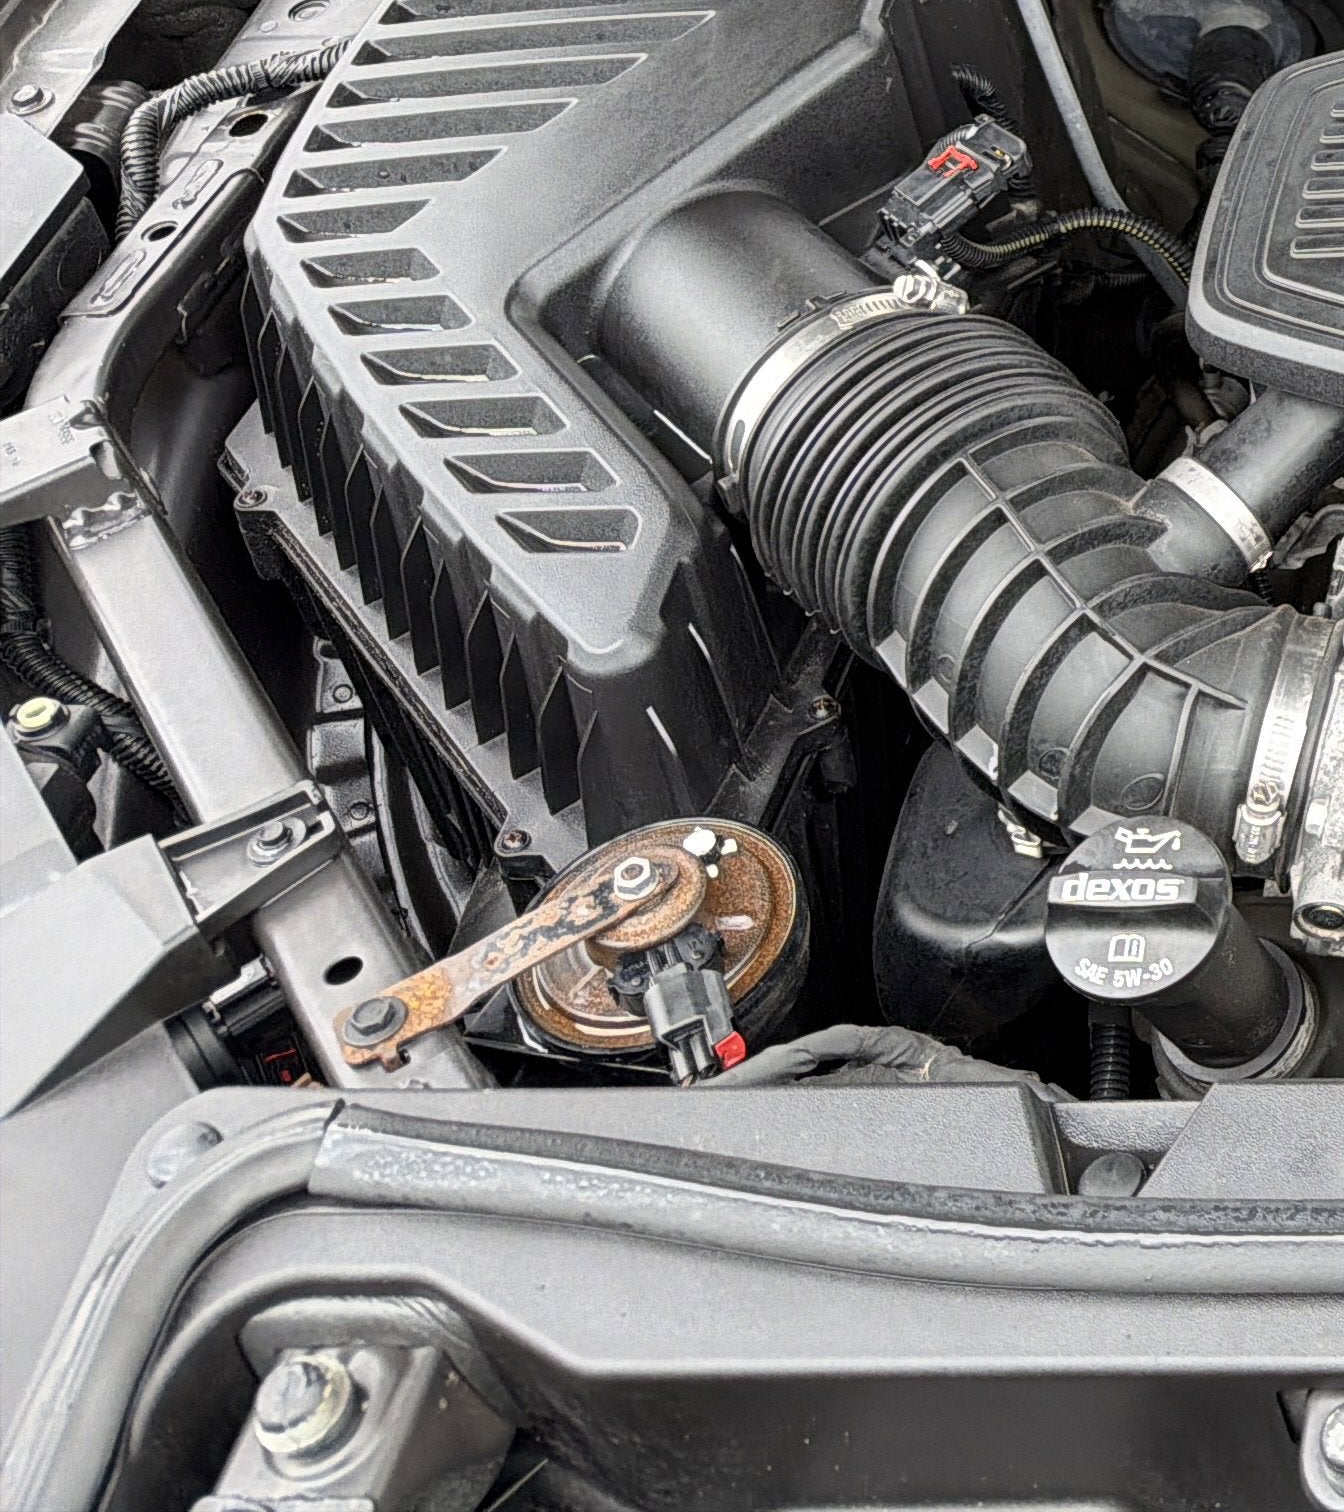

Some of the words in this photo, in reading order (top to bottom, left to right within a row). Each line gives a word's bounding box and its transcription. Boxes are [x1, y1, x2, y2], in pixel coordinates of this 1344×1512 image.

[1061, 872, 1181, 902] dexos
[1074, 958, 1109, 986] SAE
[1112, 957, 1174, 988] 5W-30
